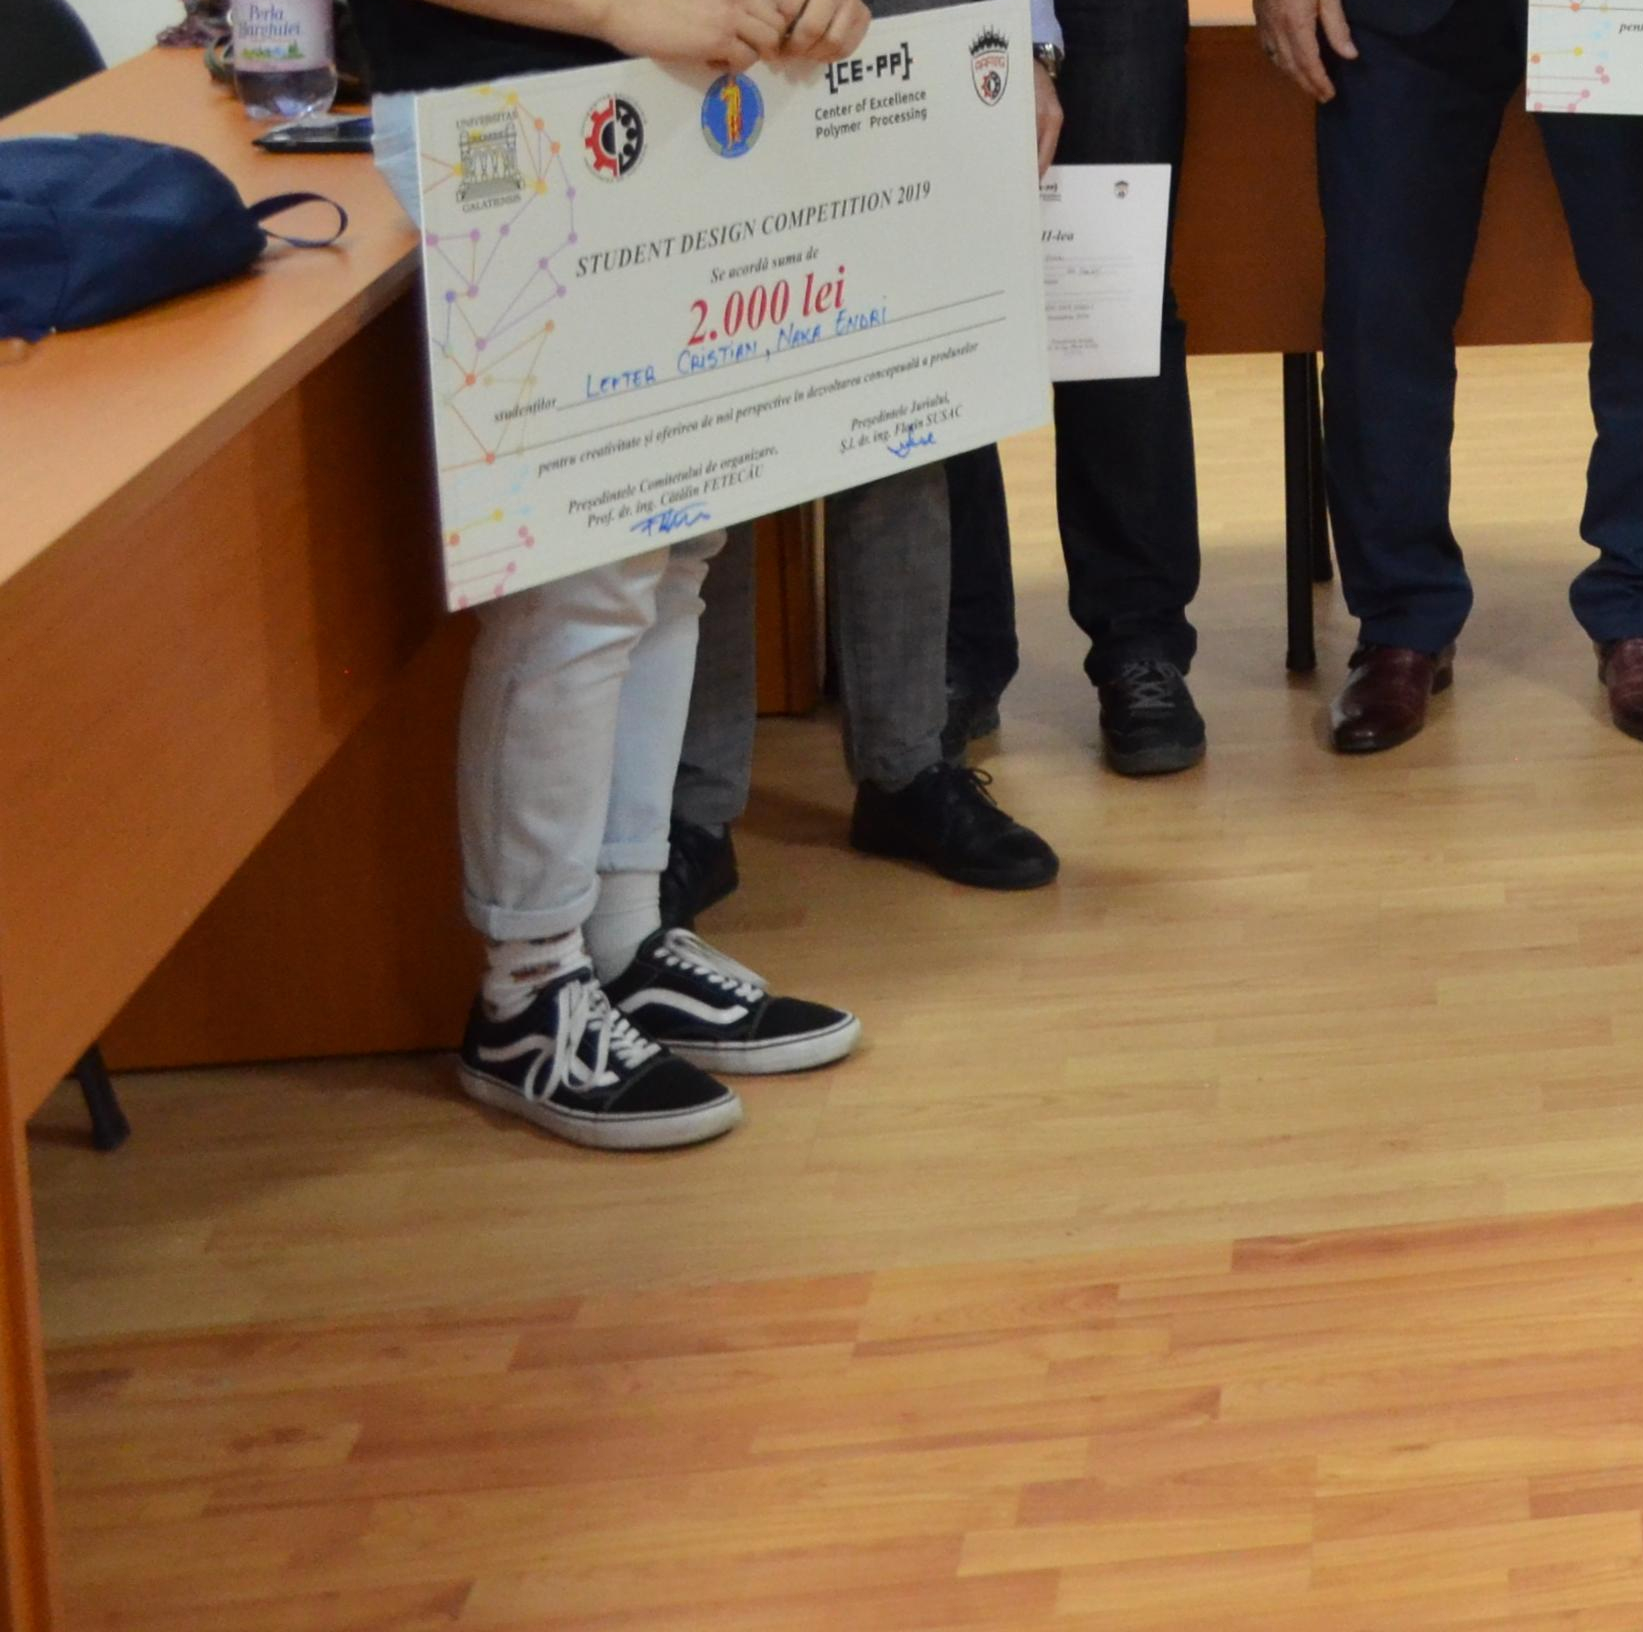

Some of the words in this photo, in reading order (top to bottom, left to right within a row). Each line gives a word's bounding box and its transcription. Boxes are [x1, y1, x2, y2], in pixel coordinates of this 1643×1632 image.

[249, 3, 284, 21] Perla
[814, 104, 852, 121] Center
[854, 97, 867, 113] of
[869, 90, 926, 110] Excellence
[815, 120, 861, 138] Polymer
[869, 107, 927, 128] Processing
[575, 237, 674, 277] STUDENT
[680, 220, 755, 254] DESIGN
[761, 190, 890, 234] COMPETITION
[896, 180, 931, 205] 2019
[687, 280, 790, 345] 2.000
[801, 264, 846, 317] lei
